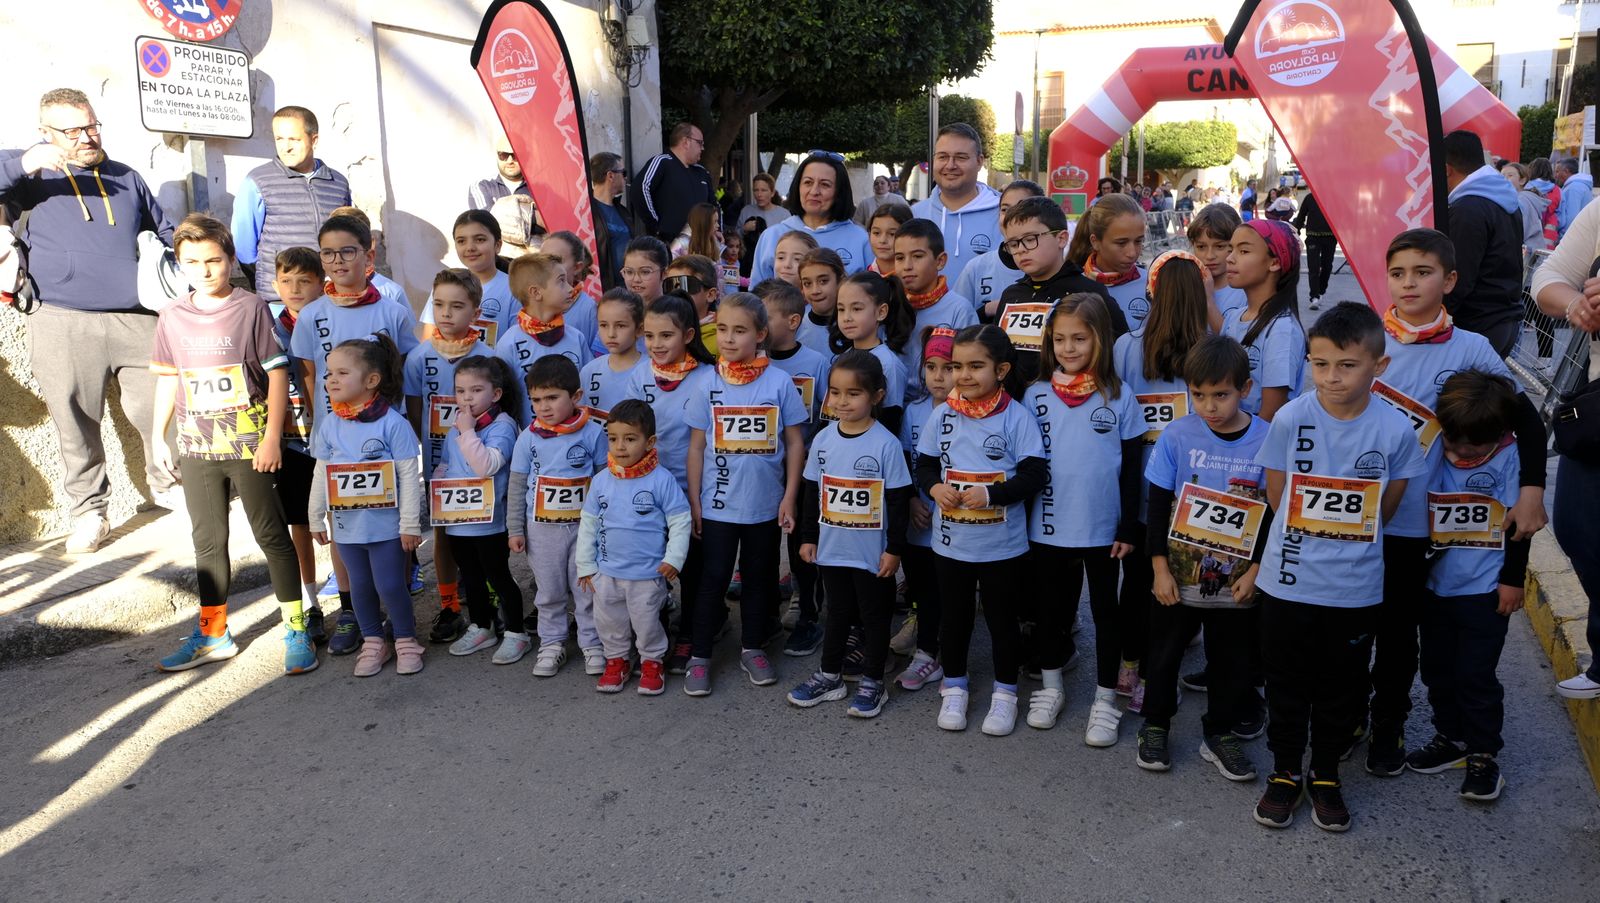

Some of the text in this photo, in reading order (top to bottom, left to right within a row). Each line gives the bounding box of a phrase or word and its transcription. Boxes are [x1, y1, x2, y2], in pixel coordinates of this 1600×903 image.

[166, 14, 177, 28] 7
[179, 21, 192, 37] h.
[196, 29, 206, 38] a
[207, 20, 223, 36] 15
[221, 15, 235, 26] h.
[174, 46, 246, 67] PROHIBIDO
[1184, 47, 1229, 61] AYU
[191, 63, 223, 75] PARAR
[181, 72, 243, 87] ESTACIONAR
[141, 81, 249, 102] EN TODA LA PLAZA
[147, 106, 167, 114] hasta
[166, 100, 194, 109] Viernes
[315, 318, 330, 337] LA
[1009, 314, 1044, 329] 754
[515, 340, 531, 360] LA
[425, 357, 438, 376] LA
[190, 377, 232, 394] 710
[590, 373, 602, 391] LA
[1036, 394, 1048, 417] LA
[1144, 406, 1173, 422] 29
[723, 417, 766, 433] 725
[942, 413, 957, 435] LA
[1296, 425, 1316, 452] LA
[1188, 448, 1207, 468] 12
[1206, 461, 1263, 473] JAIME JIMÉNEZ
[1207, 455, 1232, 463] CARRERA
[338, 473, 380, 489] 727
[441, 489, 482, 504] 732
[545, 487, 583, 503] 721
[828, 488, 870, 506] 749
[1305, 489, 1363, 513] 728
[1194, 500, 1245, 529] 734
[1437, 506, 1488, 524] 738
